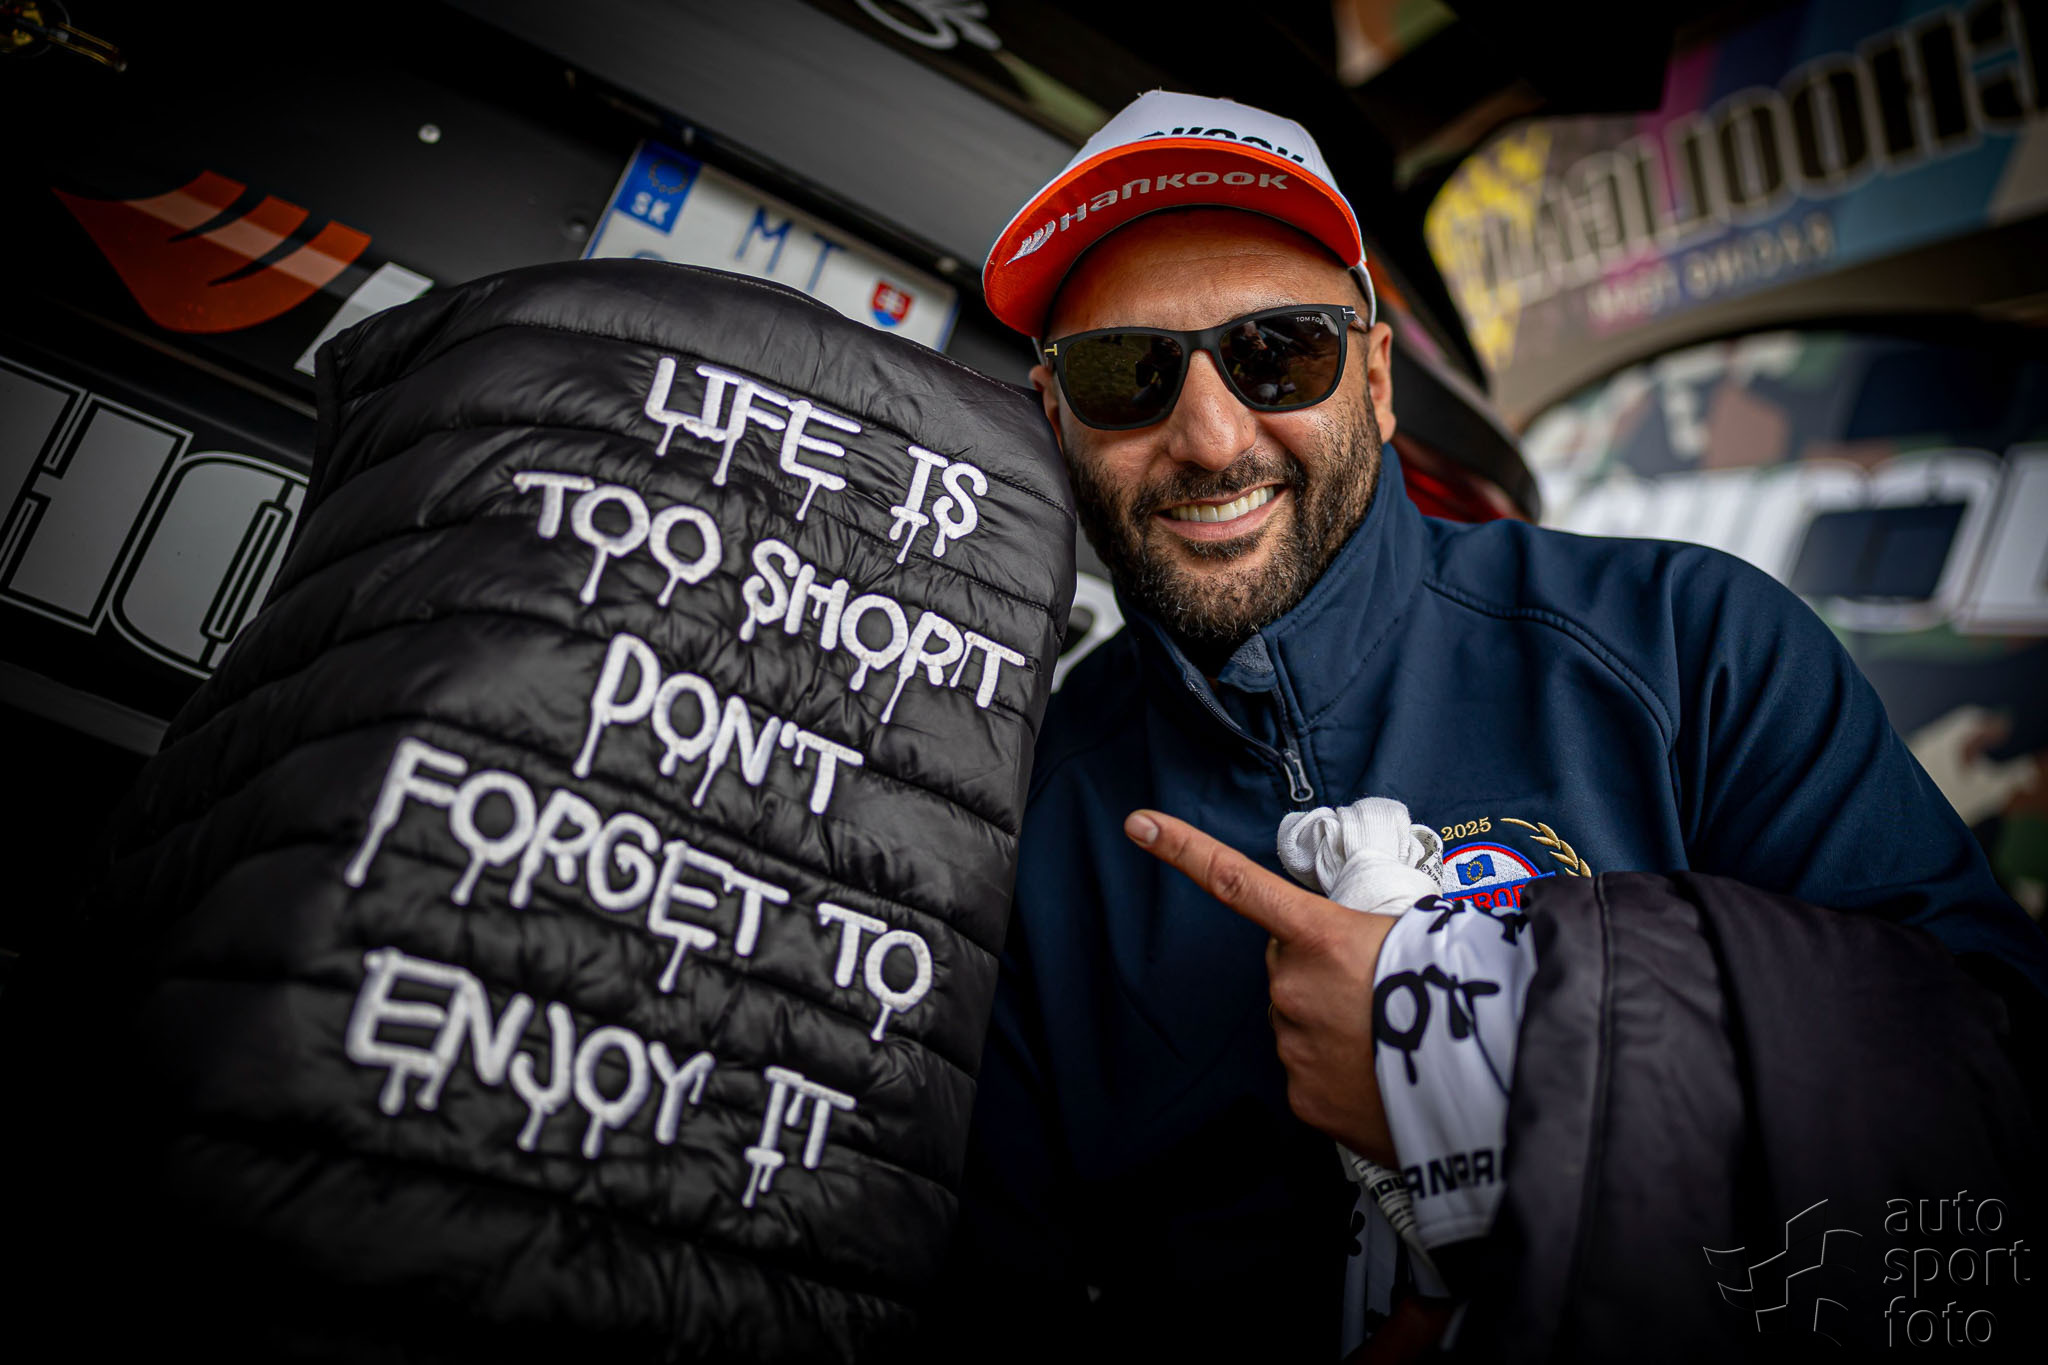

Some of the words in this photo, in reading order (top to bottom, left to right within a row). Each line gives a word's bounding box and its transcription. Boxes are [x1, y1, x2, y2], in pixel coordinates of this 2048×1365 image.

[630, 191, 671, 224] SK
[645, 357, 861, 521] LIFE
[888, 445, 989, 564] IS
[513, 470, 722, 606] TOO
[739, 538, 1026, 724] SHORT
[573, 632, 864, 814] DON'T
[344, 737, 790, 992] FORGET
[817, 902, 933, 1041] TO
[1441, 816, 1492, 841] 2025
[345, 946, 715, 1159] ENJOY
[744, 1066, 856, 1207] IT
